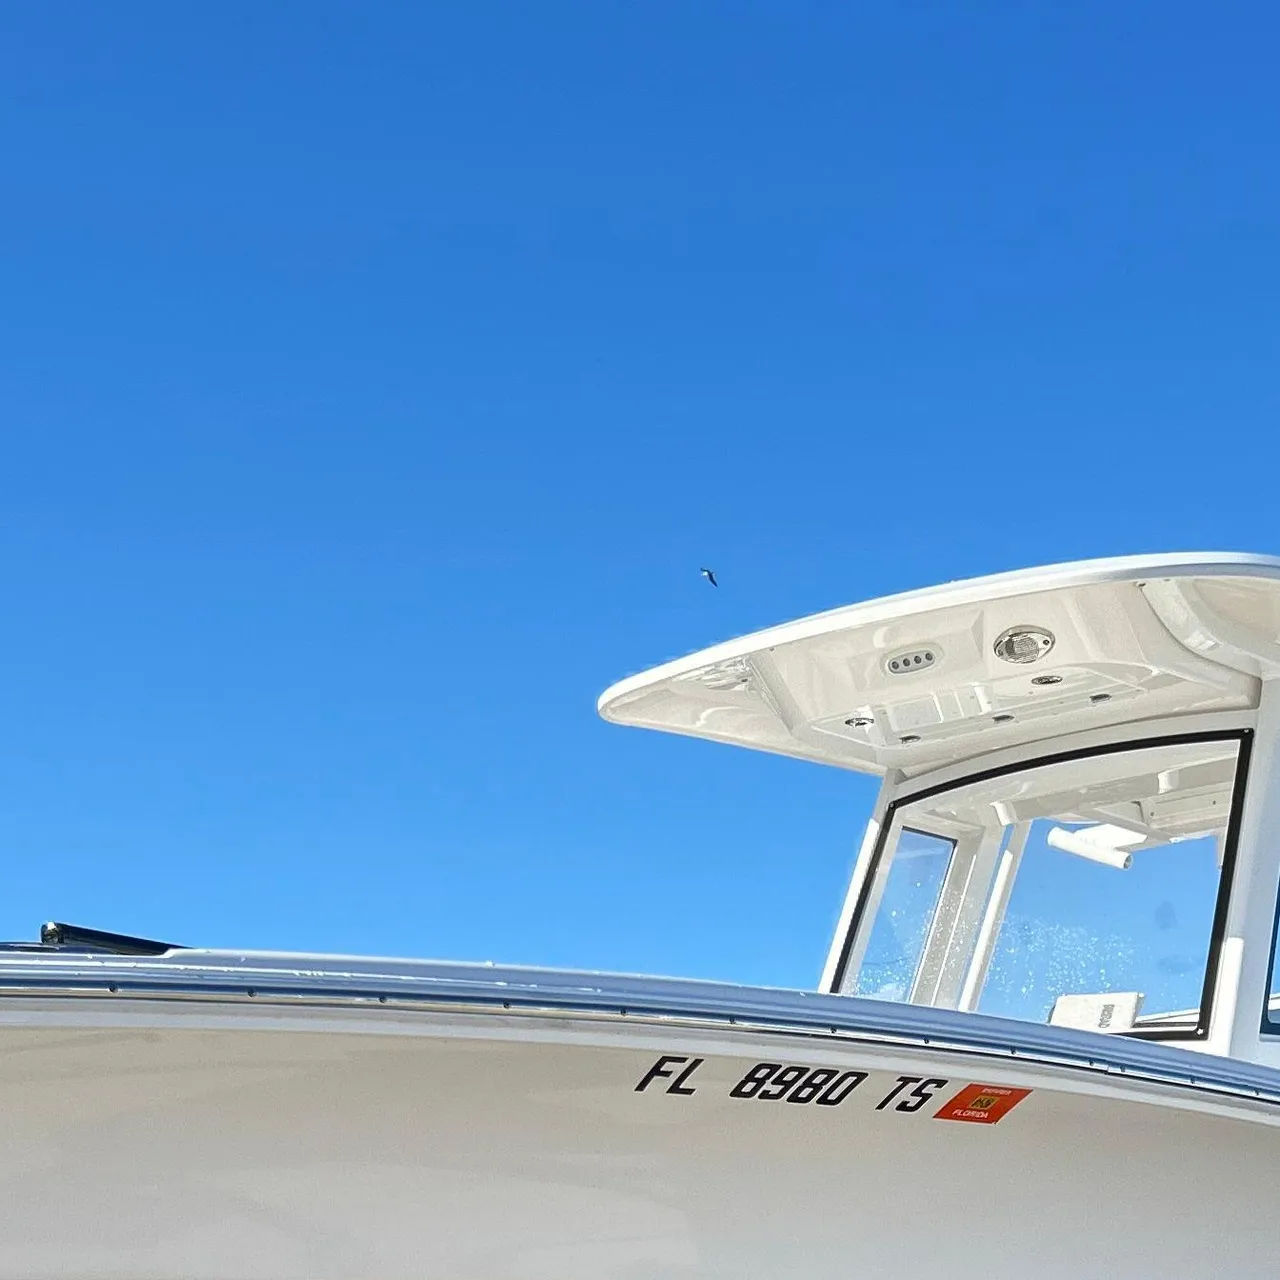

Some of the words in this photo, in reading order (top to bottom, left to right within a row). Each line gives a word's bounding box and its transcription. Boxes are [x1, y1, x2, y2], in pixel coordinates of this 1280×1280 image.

[634, 1055, 705, 1095] FL
[729, 1062, 869, 1107] 8980
[874, 1075, 948, 1113] TS
[951, 1109, 989, 1119] FLORIDA
